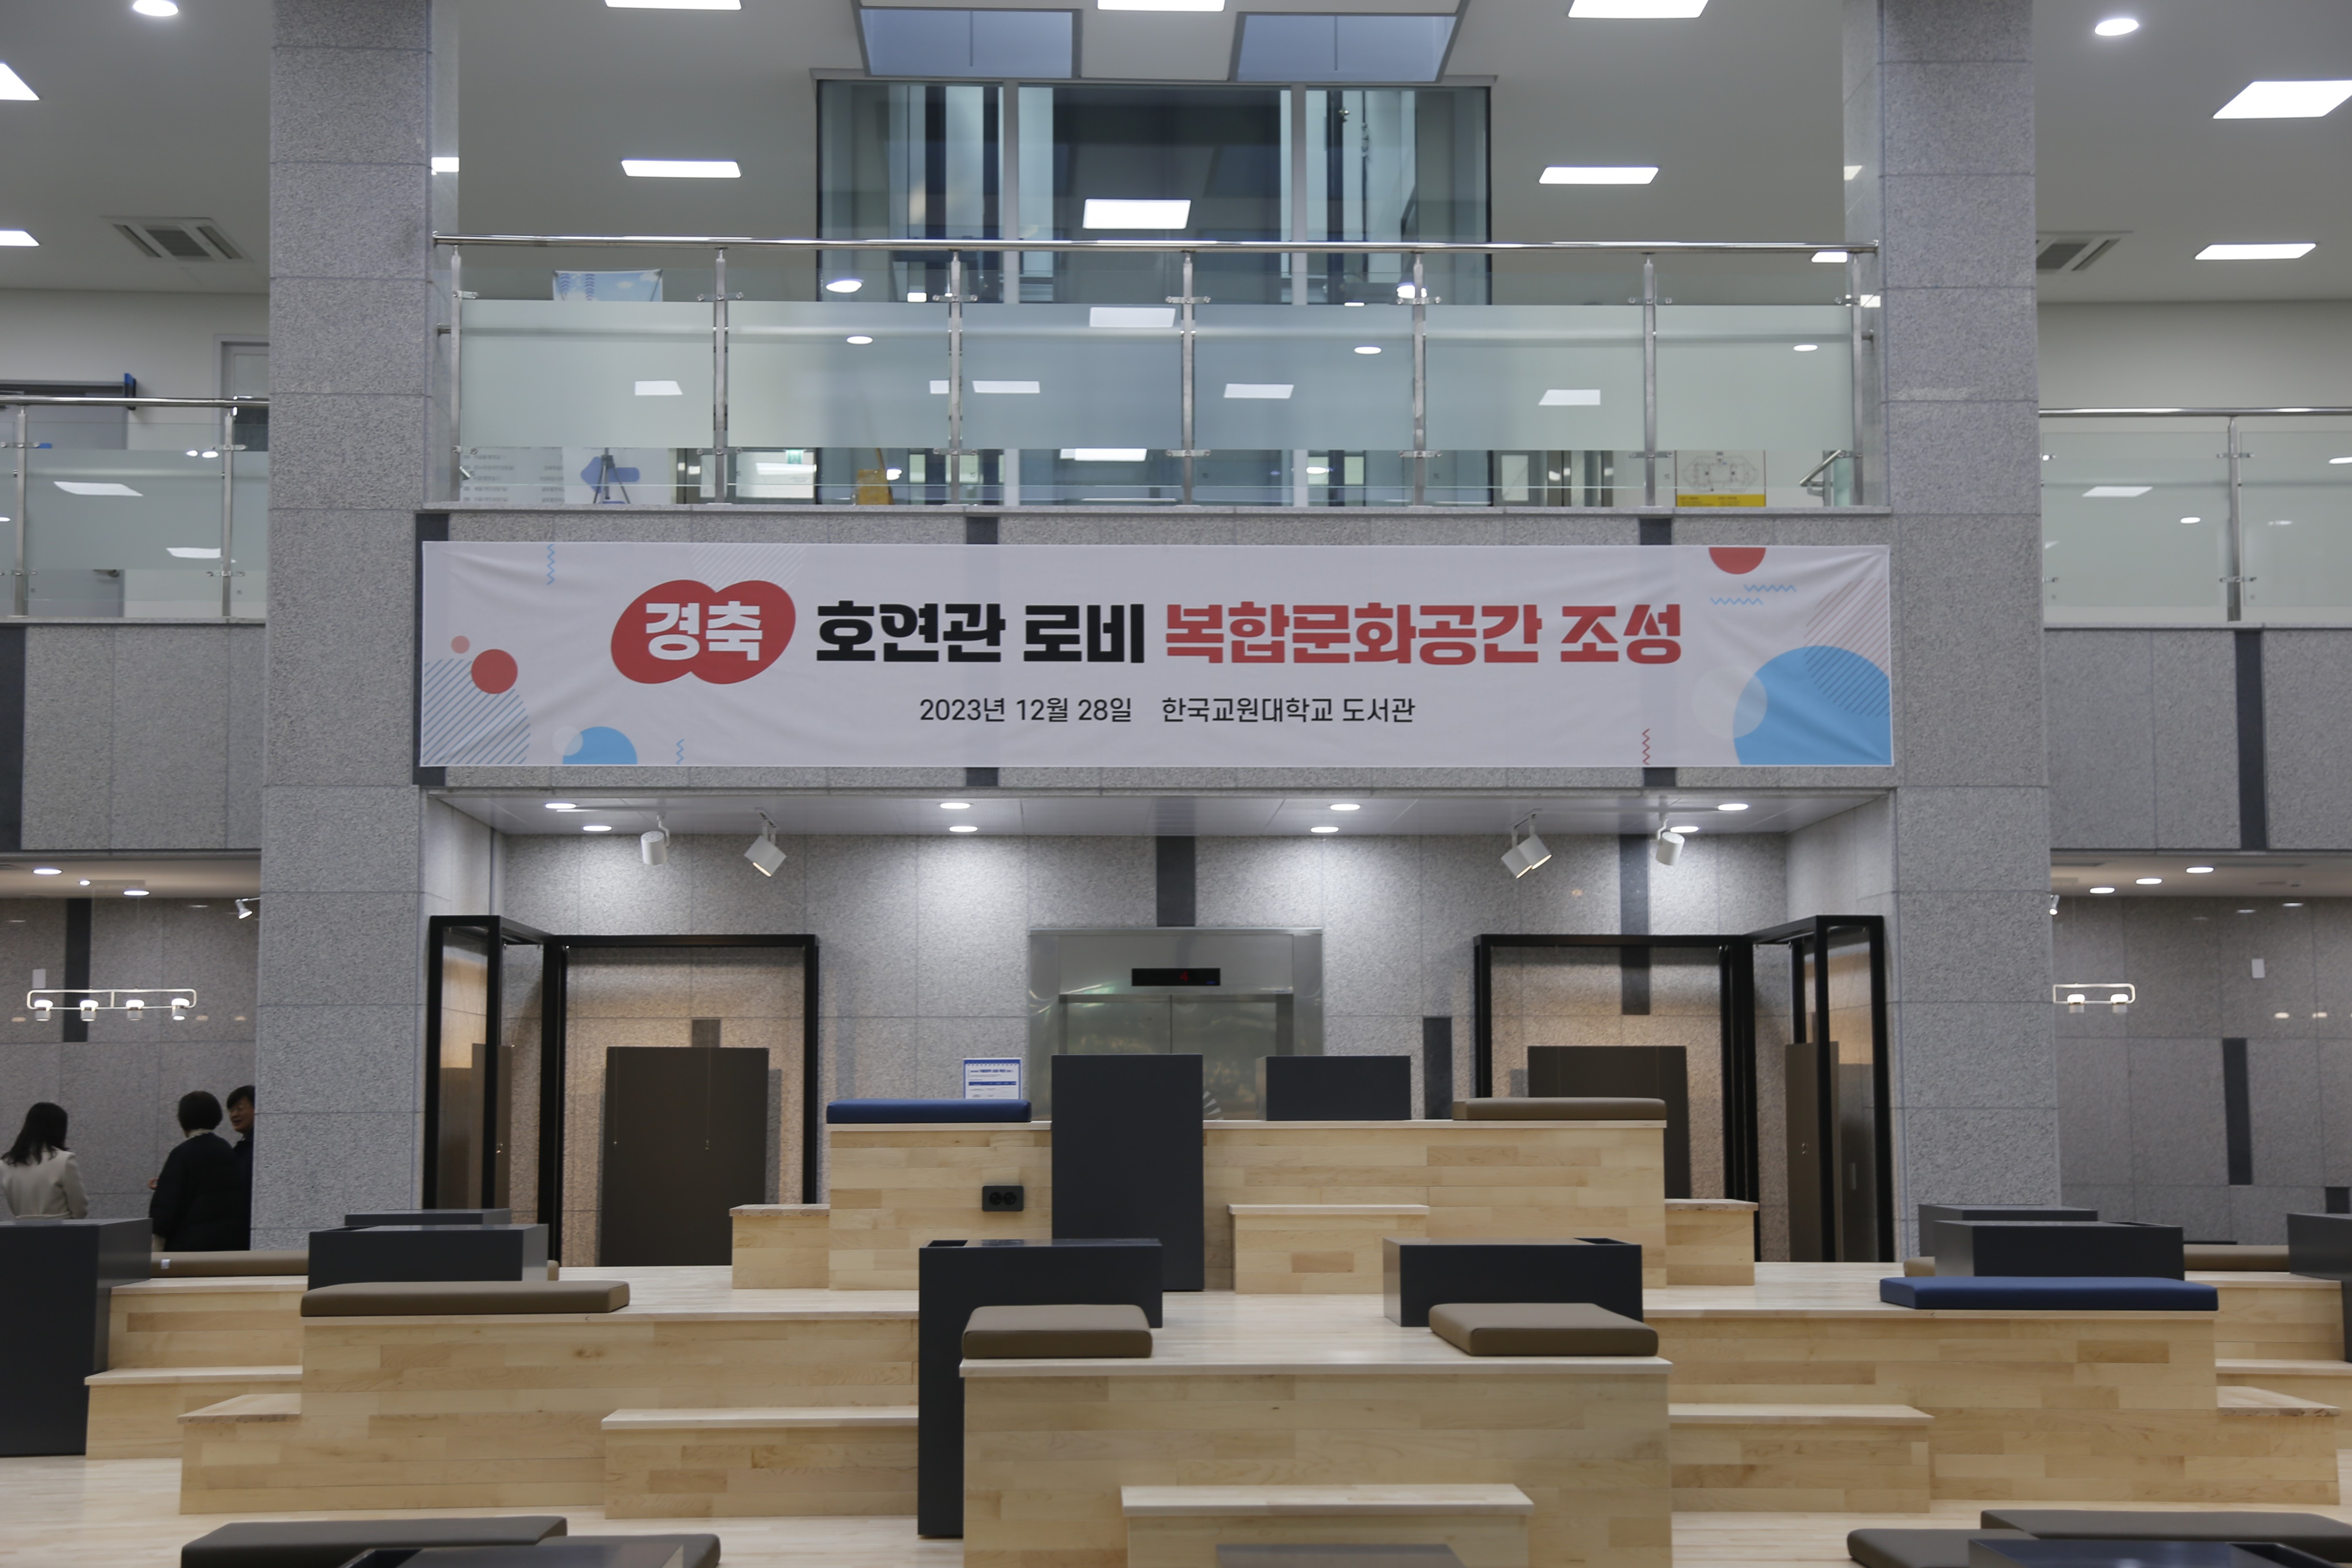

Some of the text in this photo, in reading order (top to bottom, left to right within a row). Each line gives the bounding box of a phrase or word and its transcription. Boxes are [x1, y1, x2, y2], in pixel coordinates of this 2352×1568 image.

[645, 600, 1682, 666] 경축 호연관 로비 복합문화공간 조성
[920, 697, 1132, 723] 2023년 12월 28일
[1162, 697, 1416, 723] 한국교원대학교 도서관
[1180, 971, 1189, 982] 4
